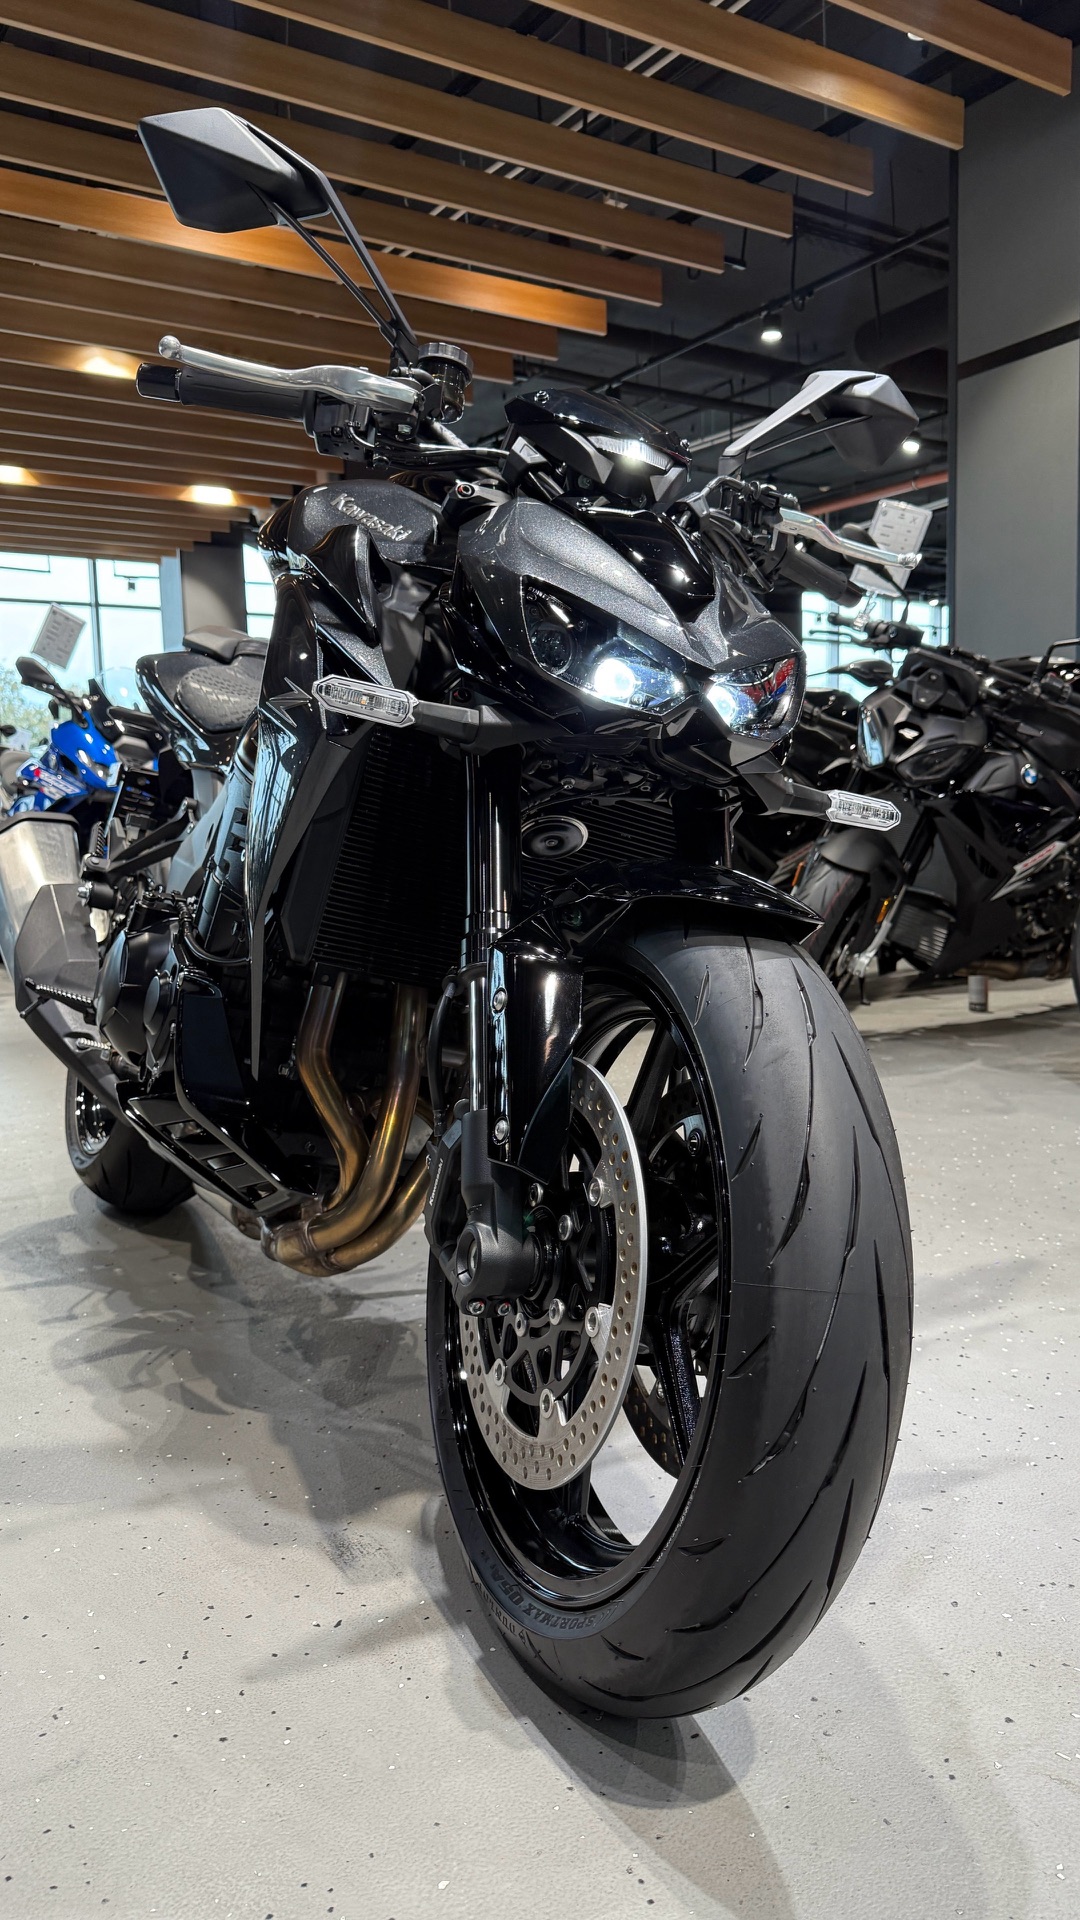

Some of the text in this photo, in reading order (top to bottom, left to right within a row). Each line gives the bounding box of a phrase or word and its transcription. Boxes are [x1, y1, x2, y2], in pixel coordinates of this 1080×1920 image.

[330, 492, 413, 542] Kawasaki
[429, 1158, 443, 1207] Kawasaki
[522, 1602, 597, 1630] SPORTMAX
